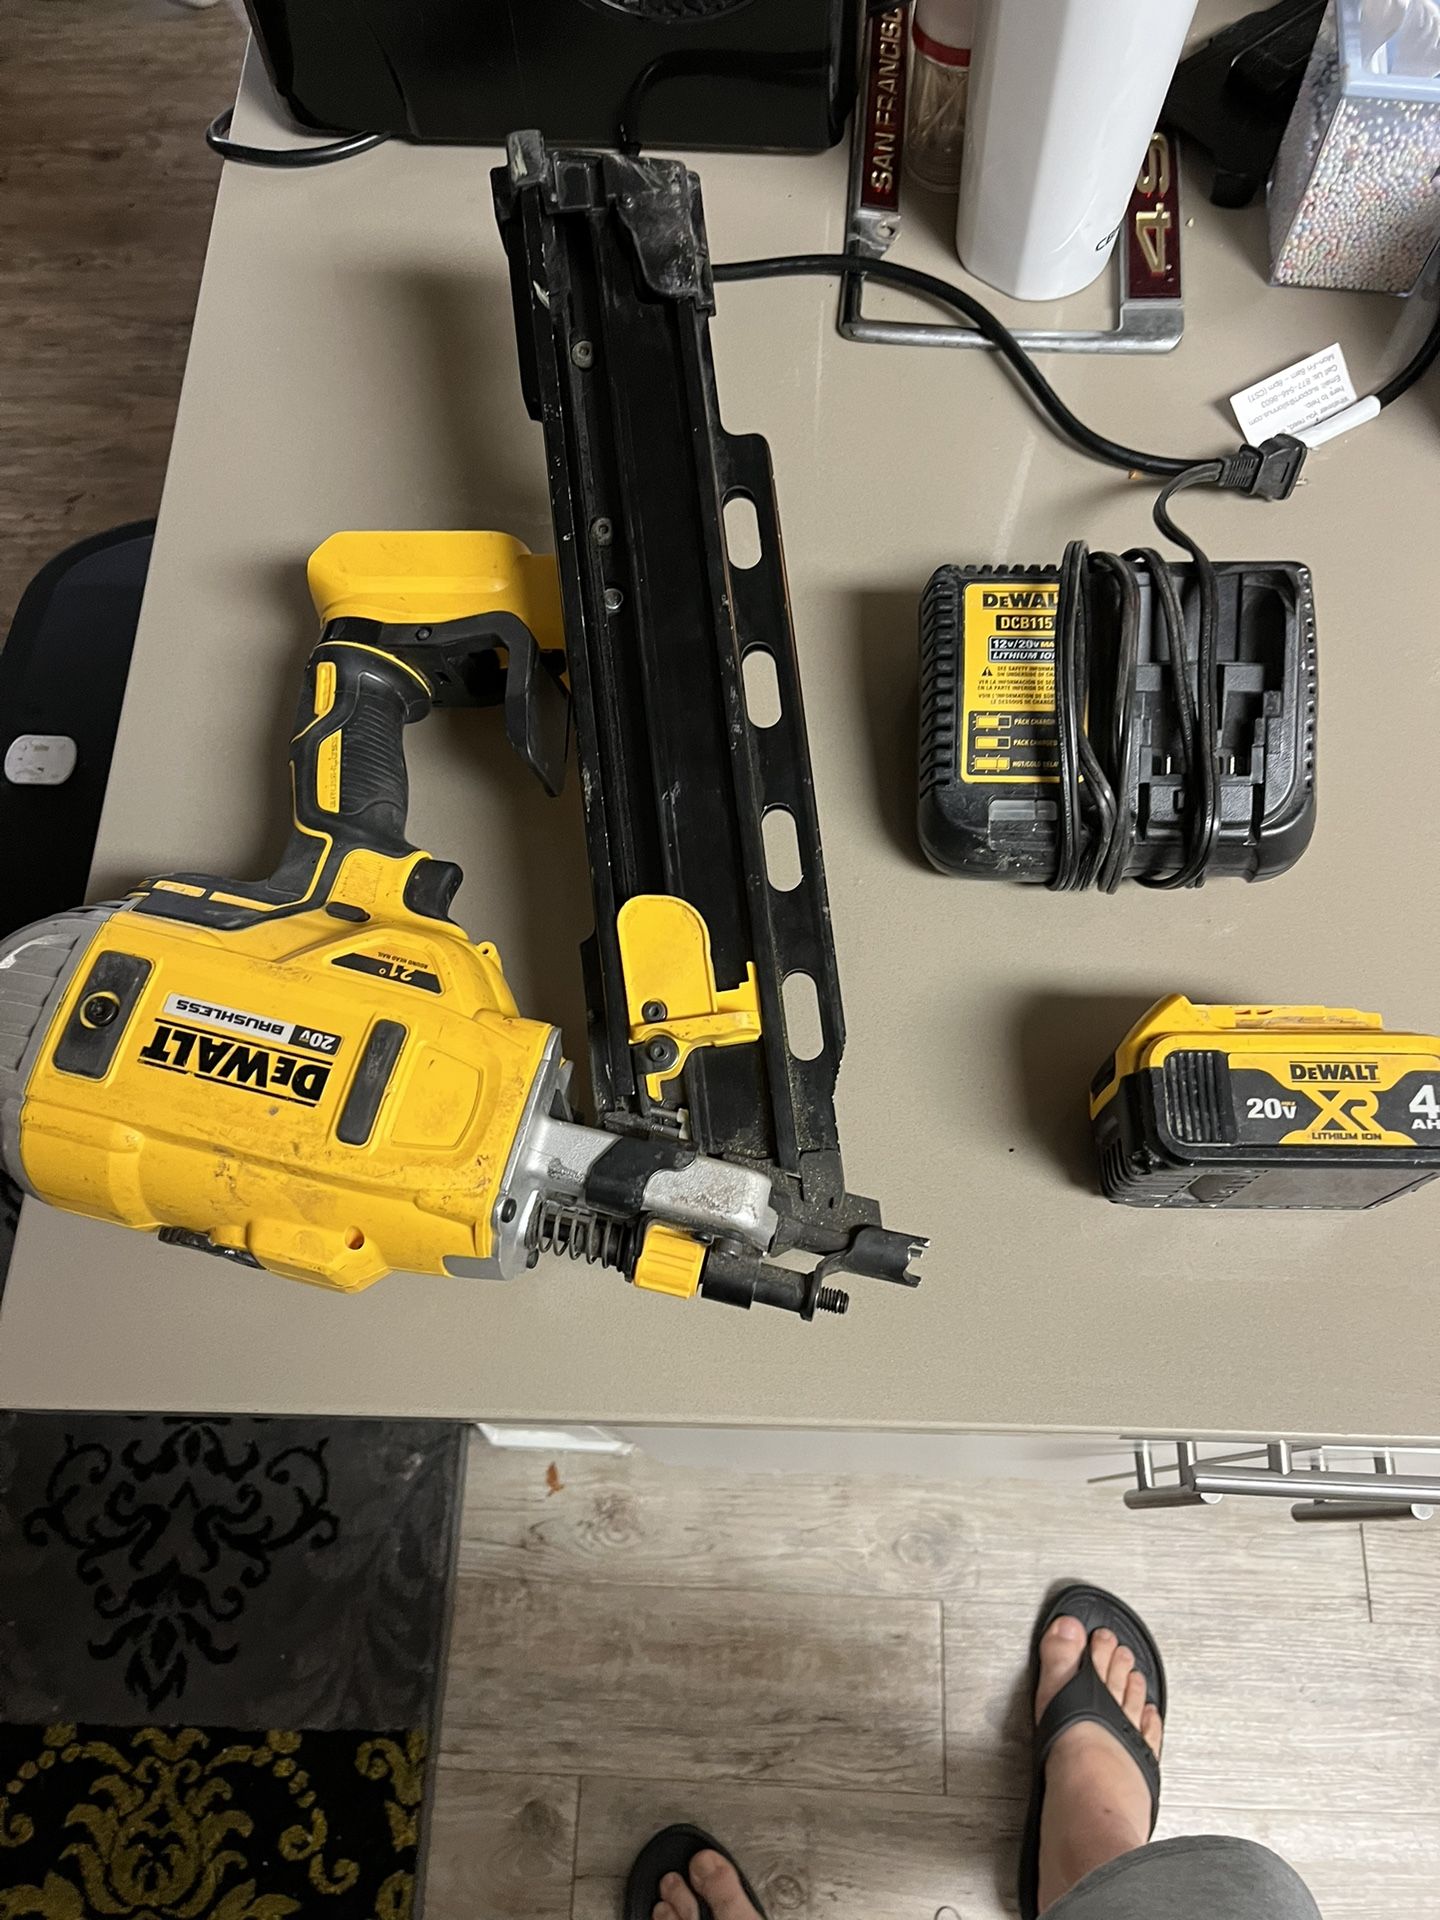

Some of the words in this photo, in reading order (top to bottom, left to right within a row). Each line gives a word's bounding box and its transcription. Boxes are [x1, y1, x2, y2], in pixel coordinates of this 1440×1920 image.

[875, 7, 903, 126] FRANCISC
[871, 131, 896, 193] SAN
[983, 592, 1058, 608] DEWAL
[1000, 616, 1053, 629] DCB115
[1040, 640, 1055, 648] MA
[176, 999, 285, 1036] BRUSHLESS
[139, 1025, 331, 1101] DEWALT
[1290, 1064, 1379, 1080] DEWALT
[1302, 1090, 1386, 1131] XR
[1312, 1132, 1358, 1140] LITHIUM
